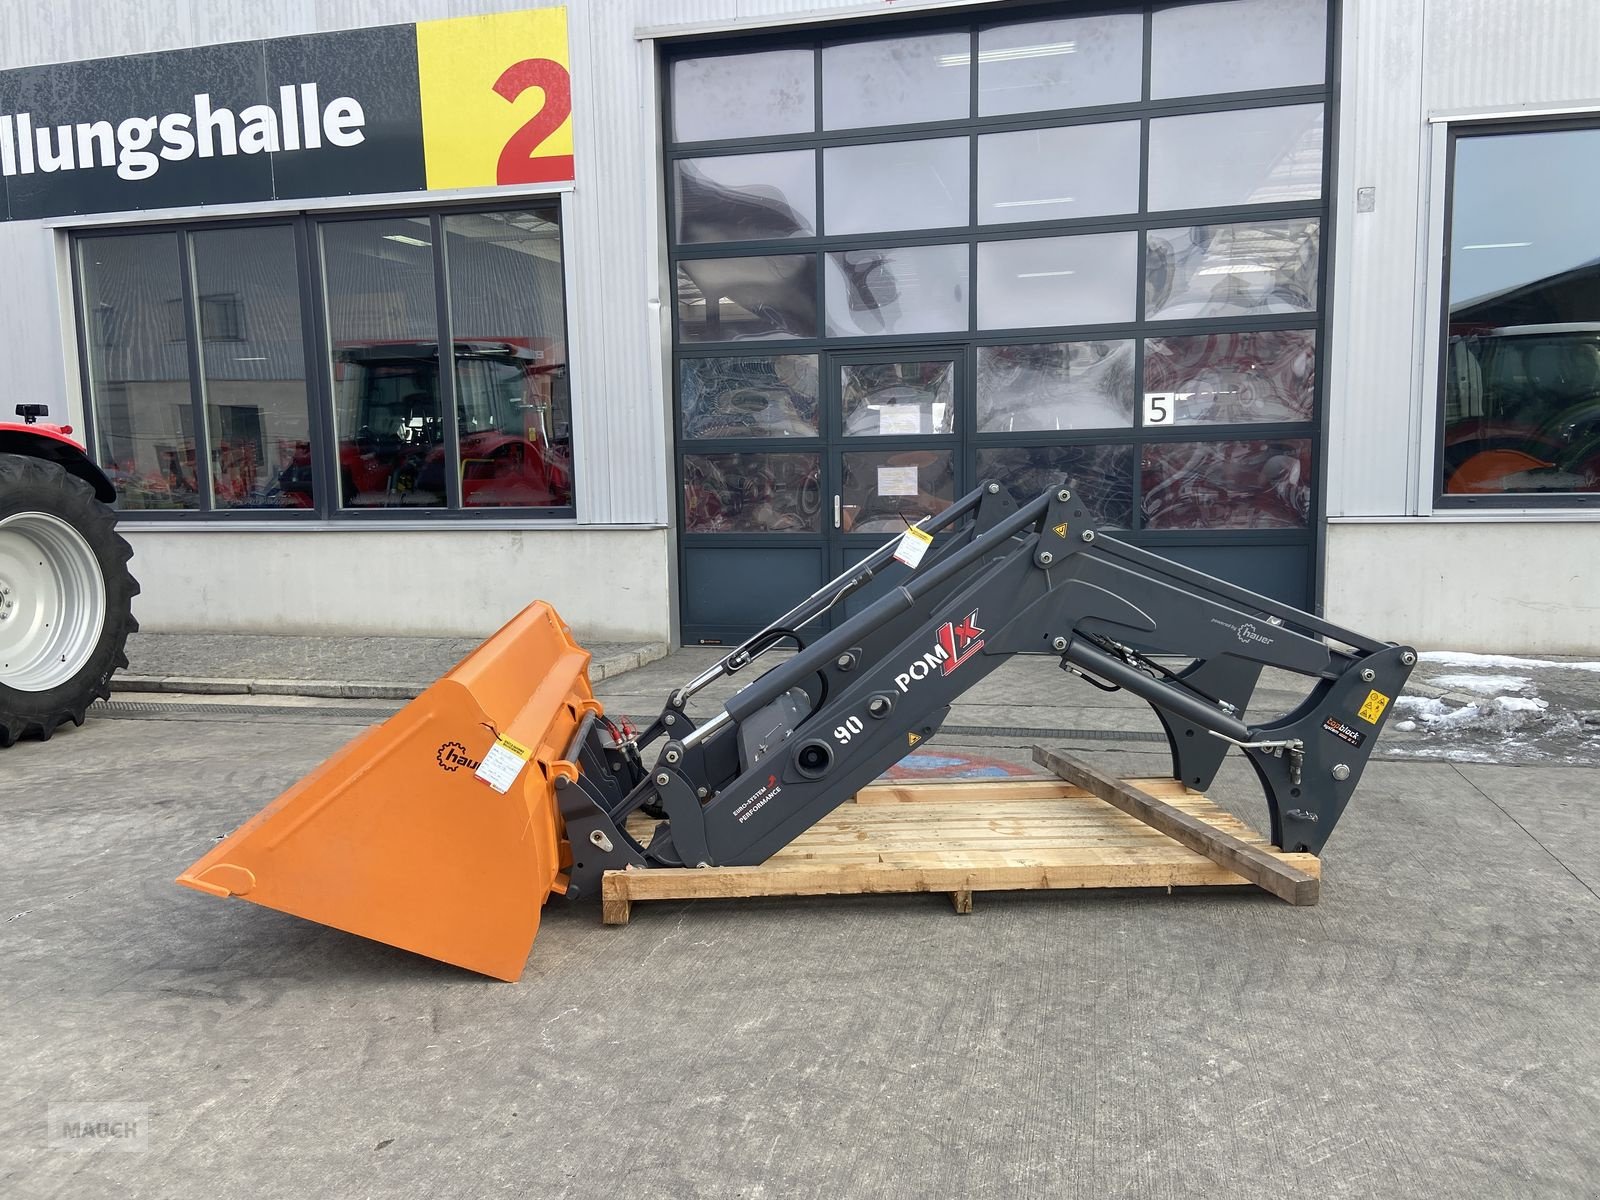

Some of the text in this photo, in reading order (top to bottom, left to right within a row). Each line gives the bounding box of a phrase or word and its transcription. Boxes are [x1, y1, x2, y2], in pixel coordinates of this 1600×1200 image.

[492, 58, 575, 186] 2
[1150, 397, 1167, 423] 5
[1242, 627, 1275, 645] hauer
[834, 716, 864, 745] 90
[1326, 717, 1360, 741] topblock
[445, 748, 482, 771] hau
[732, 786, 767, 817] EURO-SYSTEM
[738, 786, 782, 824] PERFORMANCE
